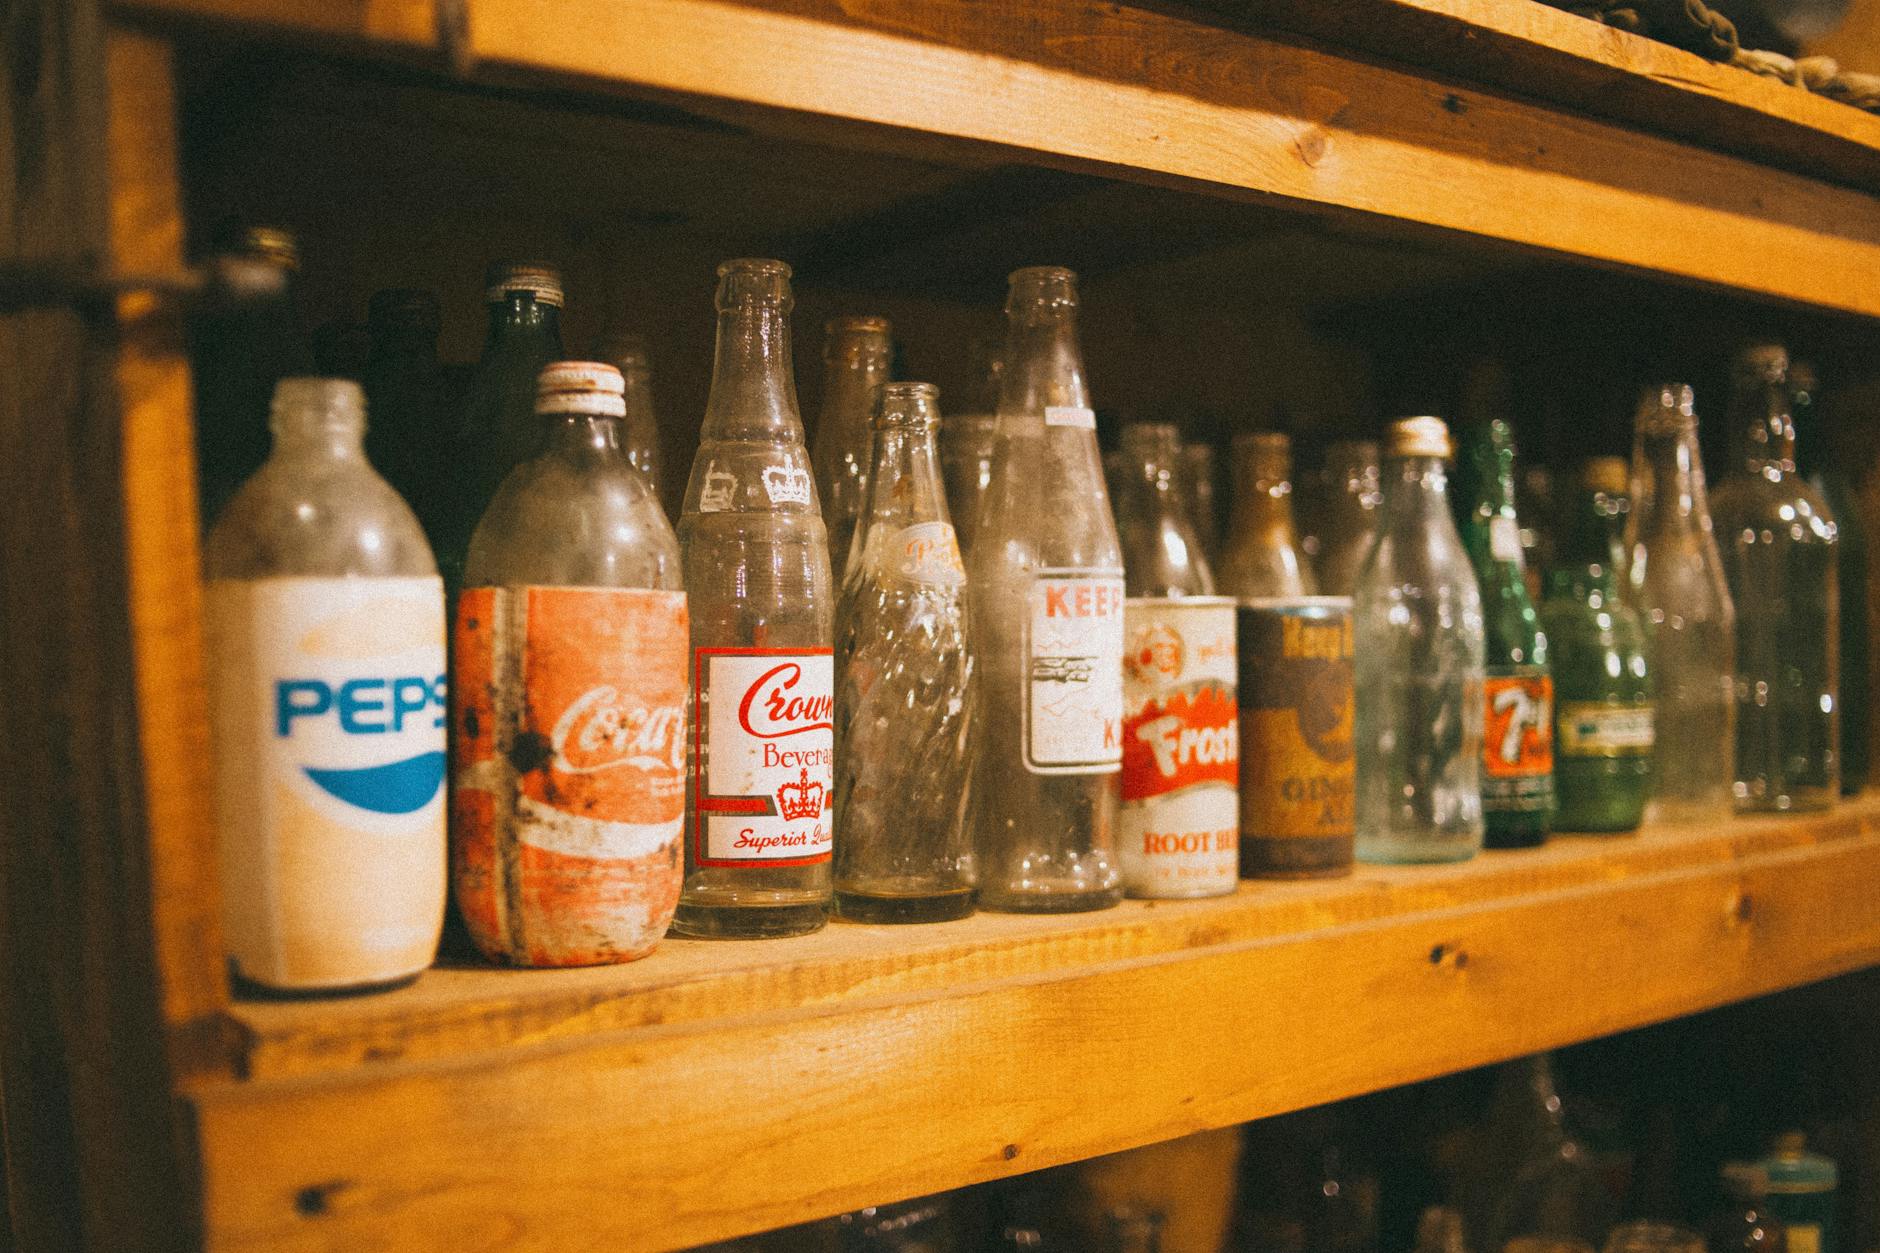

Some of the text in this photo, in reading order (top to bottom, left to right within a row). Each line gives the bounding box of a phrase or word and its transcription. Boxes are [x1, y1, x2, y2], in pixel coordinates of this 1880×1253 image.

[739, 662, 832, 738] Crown
[733, 828, 807, 853] Superior
[1143, 832, 1210, 855] ROOT
